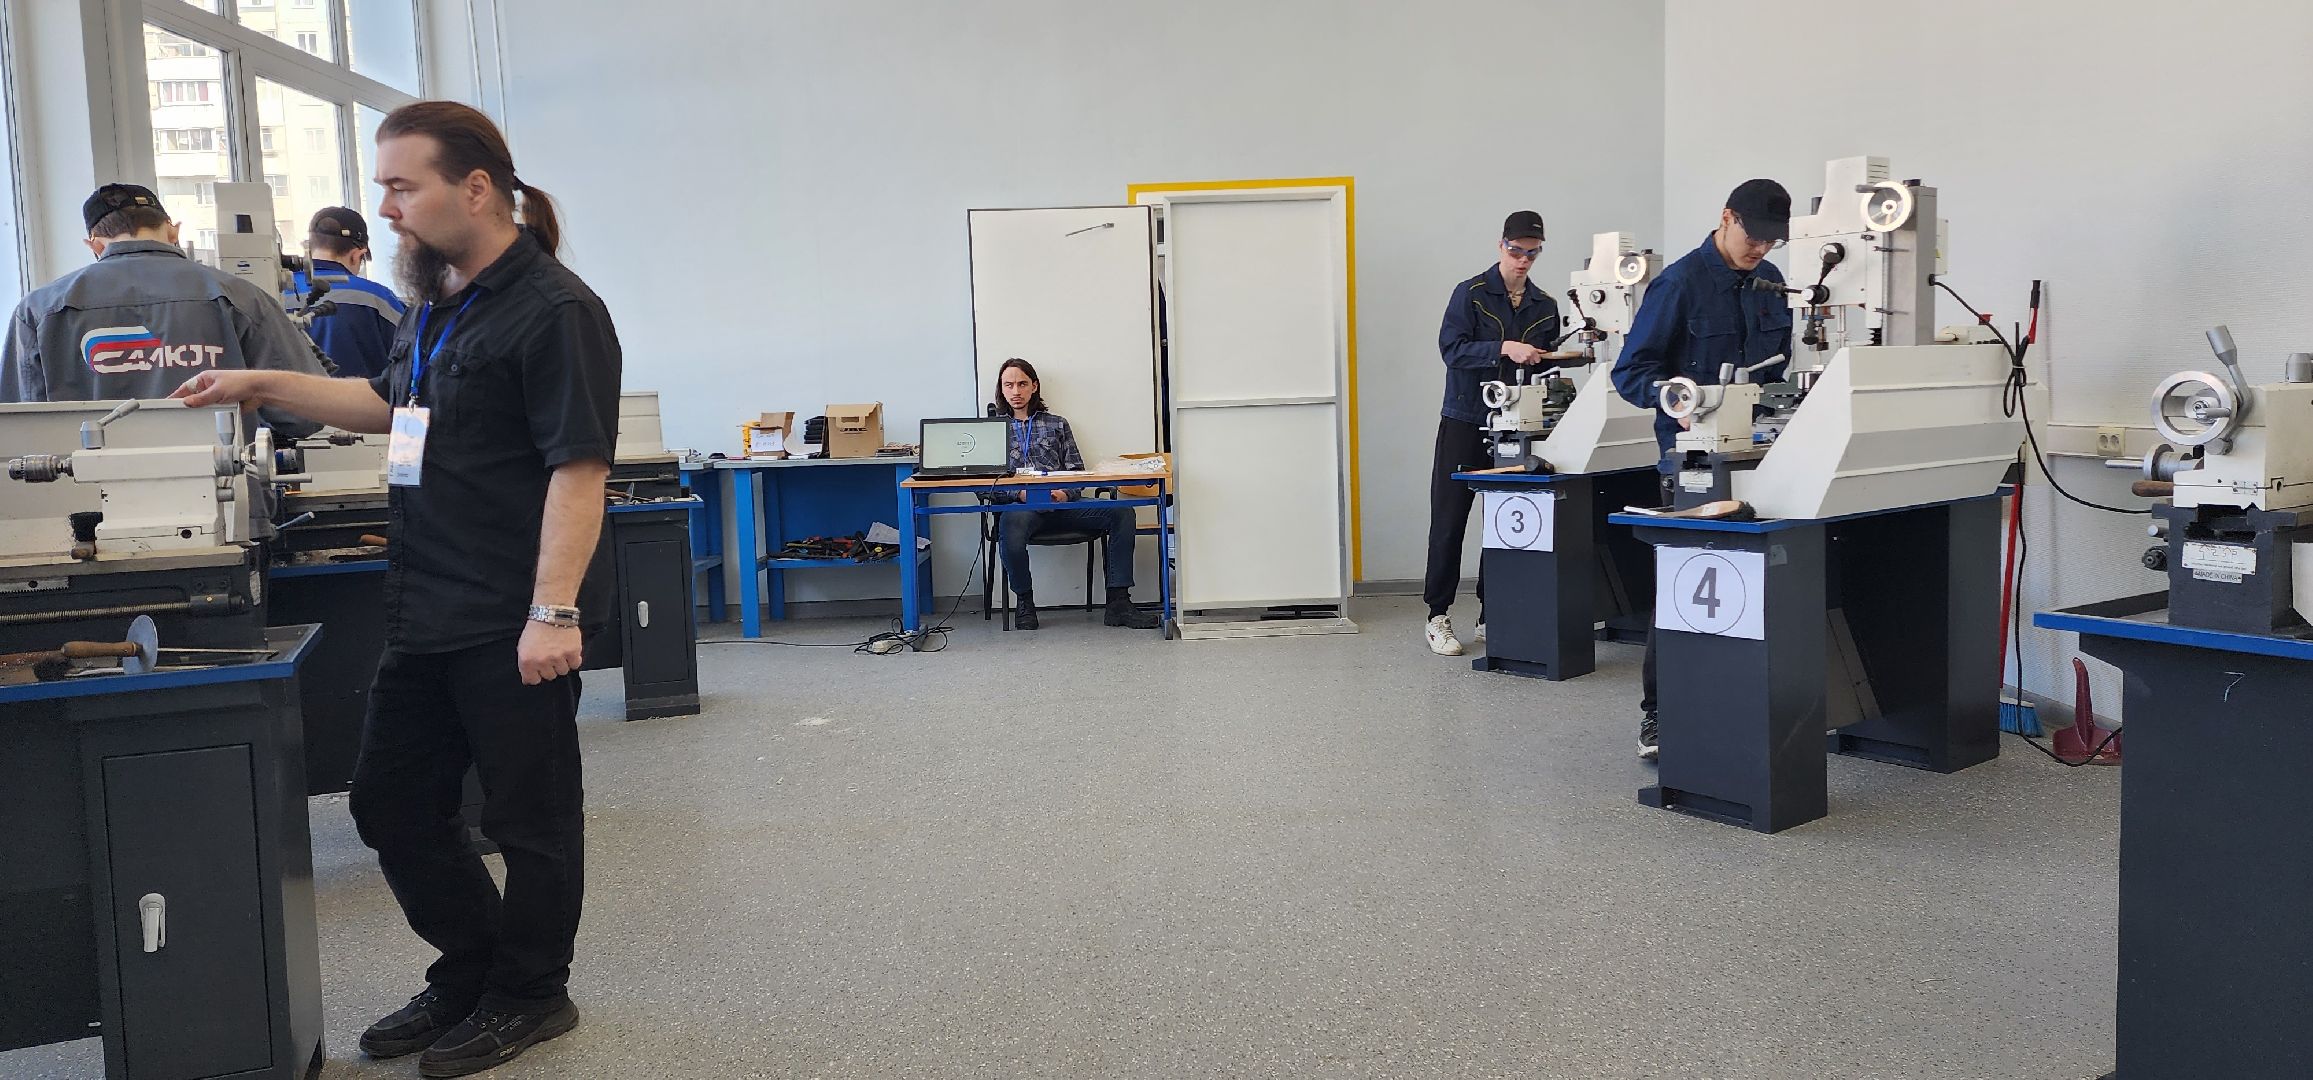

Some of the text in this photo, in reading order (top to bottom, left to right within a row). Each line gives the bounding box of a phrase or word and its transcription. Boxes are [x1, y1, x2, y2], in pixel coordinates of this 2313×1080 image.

[1511, 510, 1525, 533] 3
[2220, 573, 2238, 581] CHINA
[1692, 567, 1721, 618] 4
[2224, 671, 2246, 703] 7
